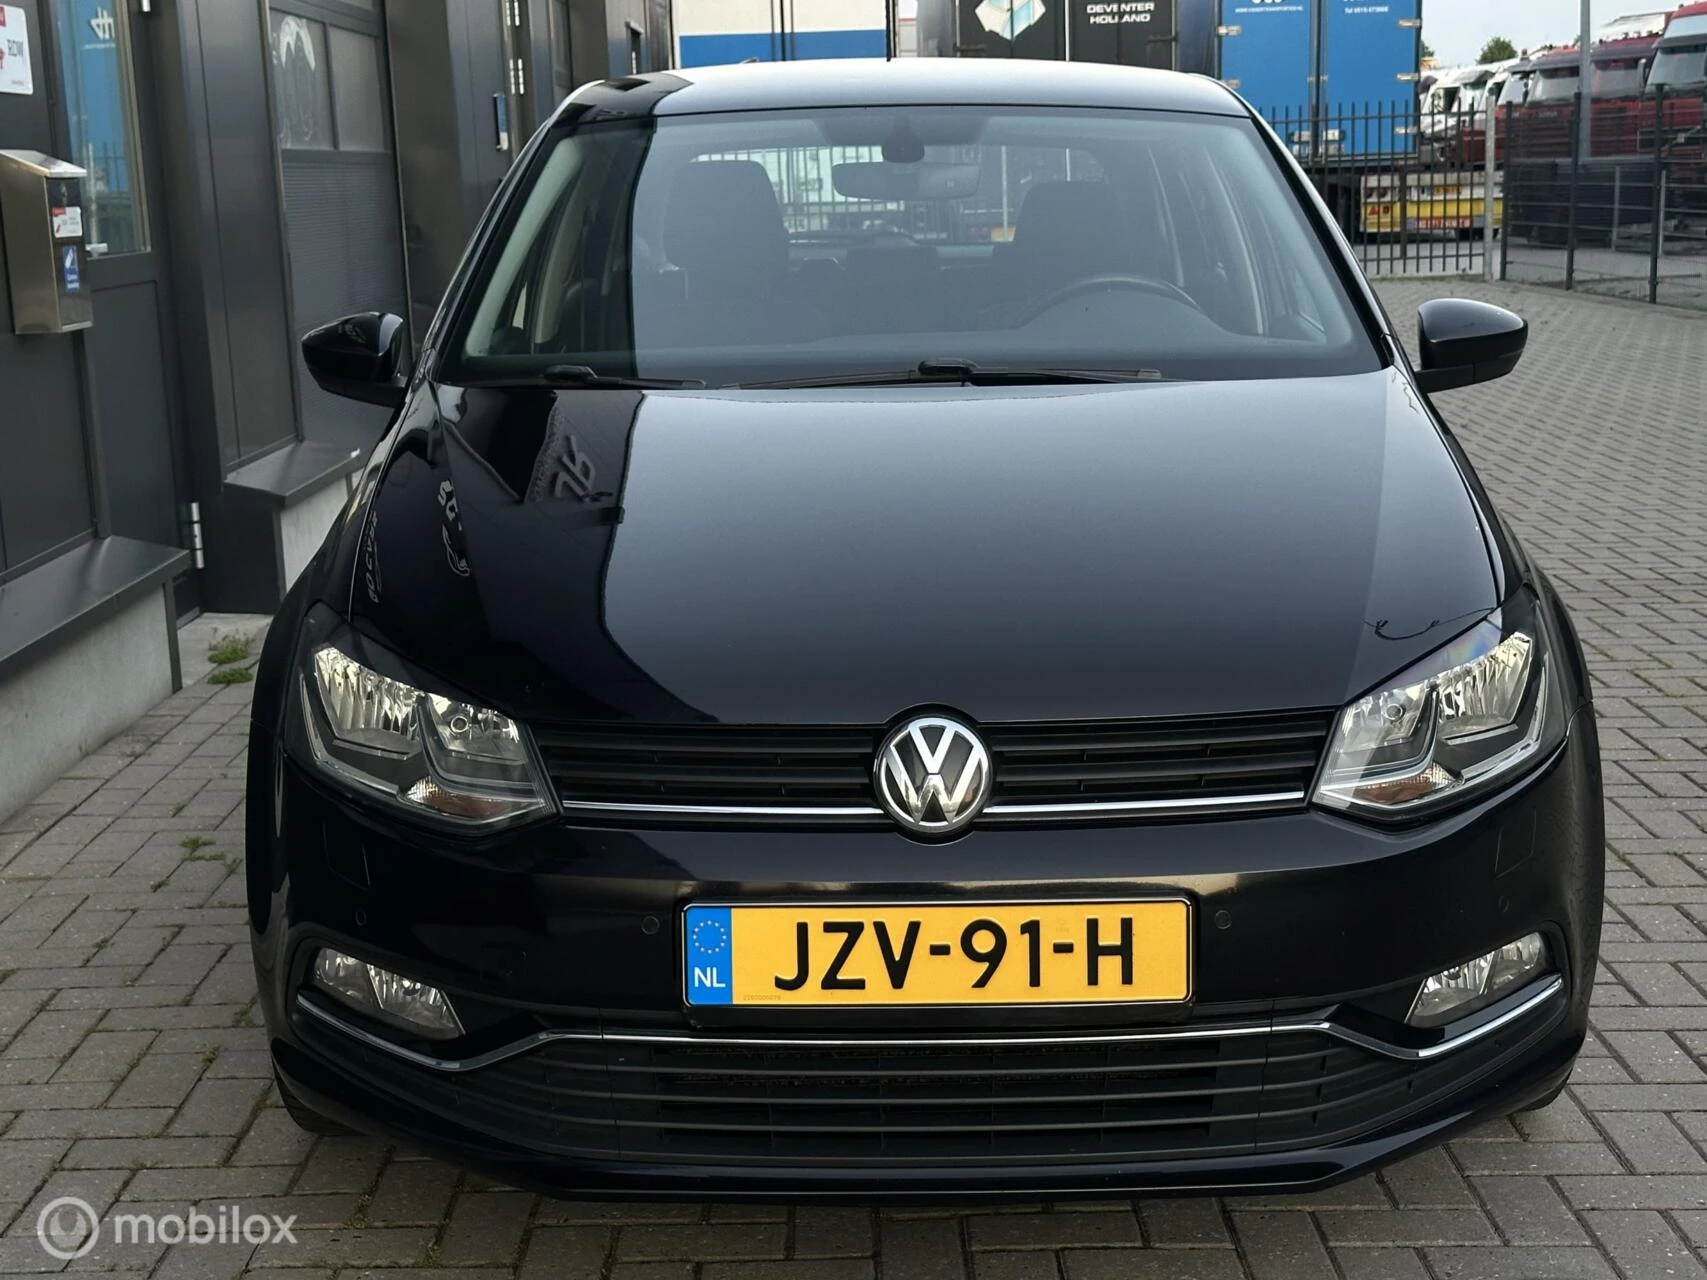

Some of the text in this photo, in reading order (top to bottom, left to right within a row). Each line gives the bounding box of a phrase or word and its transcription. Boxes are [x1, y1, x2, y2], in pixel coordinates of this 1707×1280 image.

[1086, 2, 1155, 13] DEVENTER
[1089, 13, 1151, 24] HOLLAND
[694, 917, 1134, 991] NL JZV-91-H
